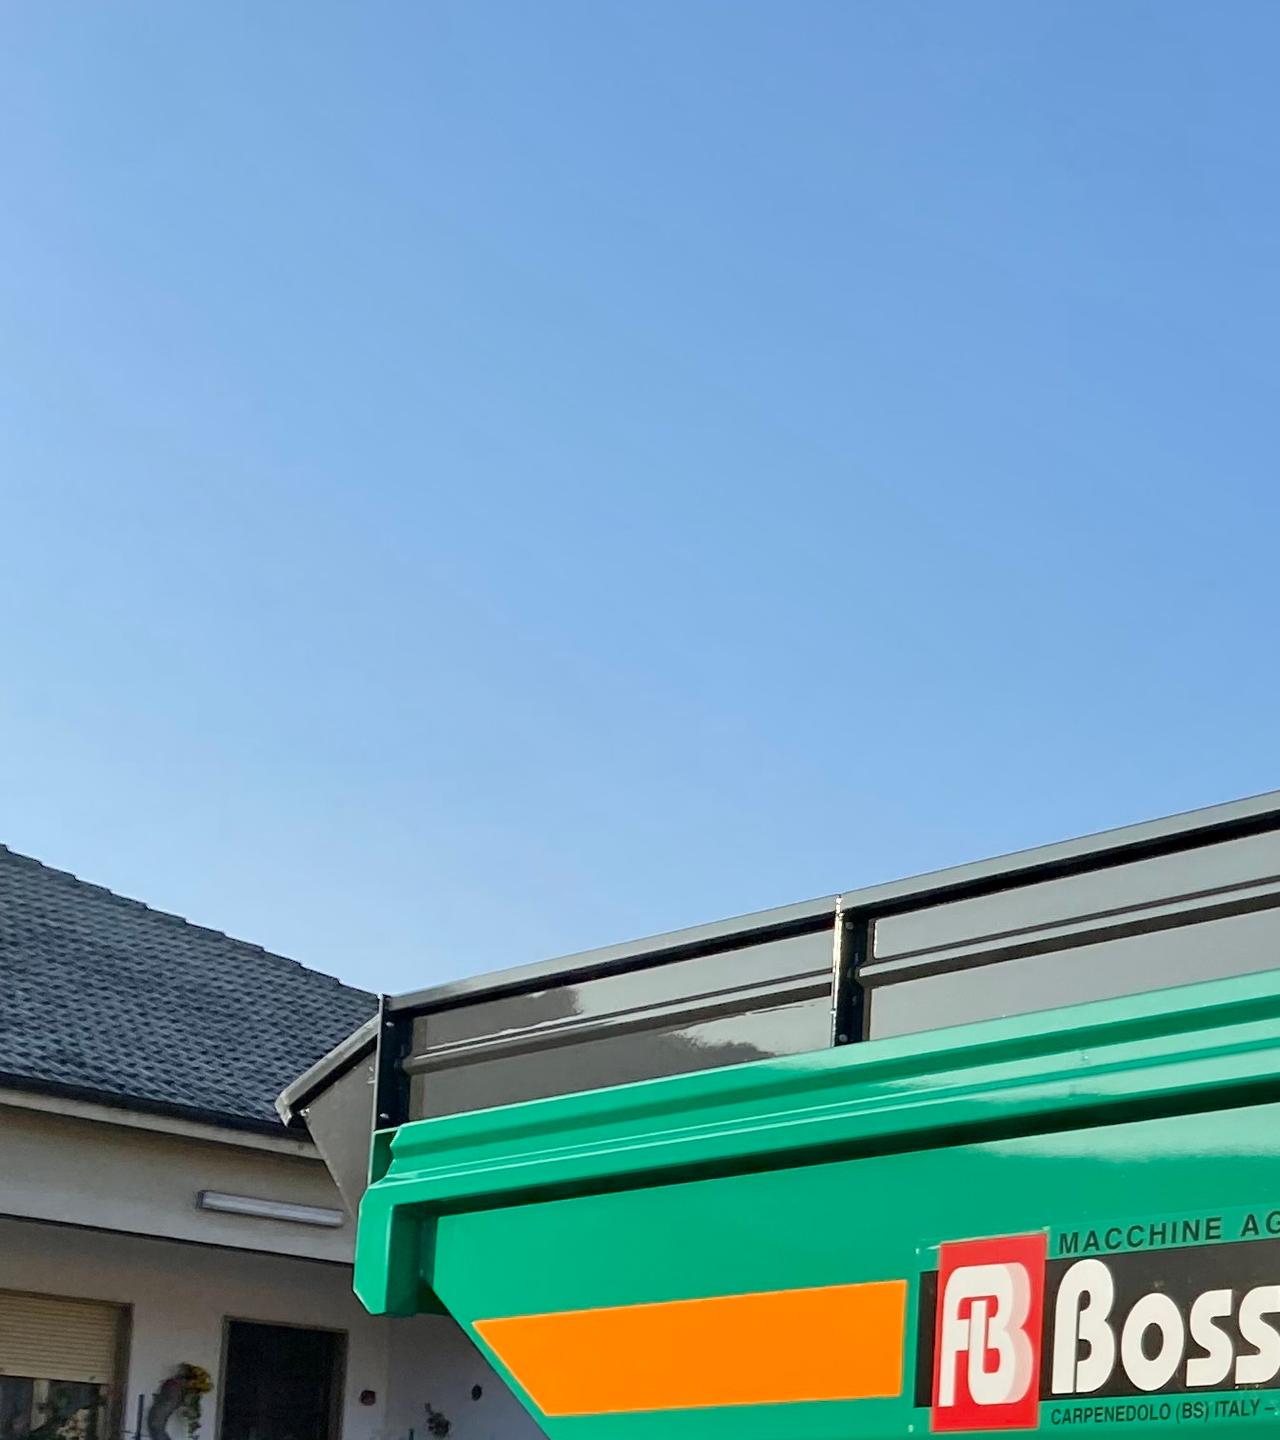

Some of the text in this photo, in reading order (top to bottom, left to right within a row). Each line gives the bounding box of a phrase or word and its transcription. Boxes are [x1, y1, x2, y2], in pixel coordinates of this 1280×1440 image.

[1058, 1216, 1223, 1254] MACCHINE
[1051, 1403, 1172, 1425] CARPENEDOLO
[1175, 1401, 1210, 1424] (BS)
[1214, 1399, 1260, 1420] ITALY
